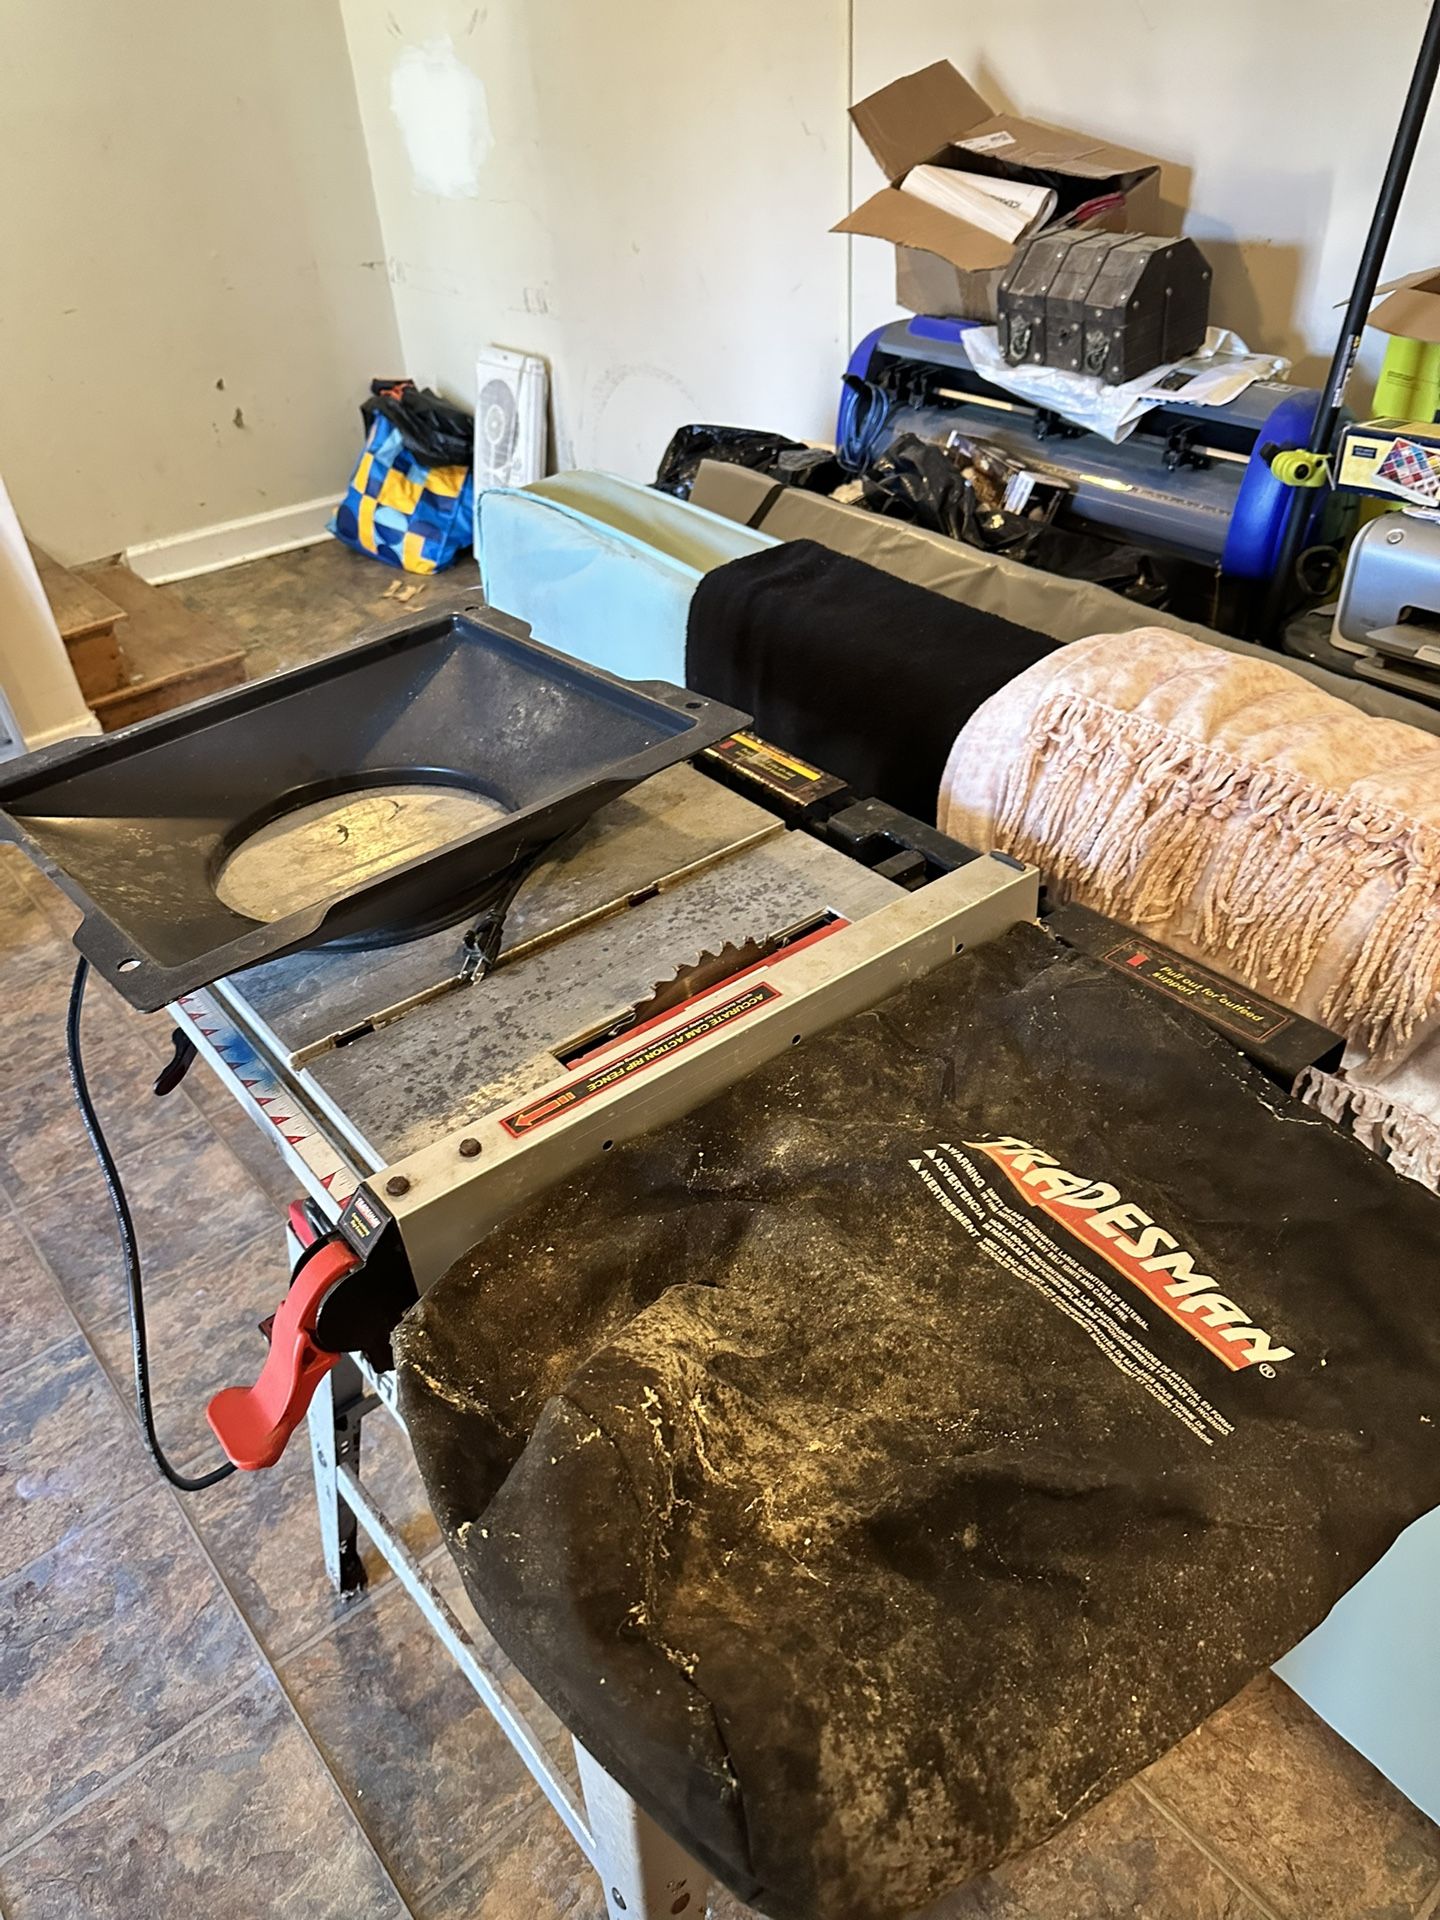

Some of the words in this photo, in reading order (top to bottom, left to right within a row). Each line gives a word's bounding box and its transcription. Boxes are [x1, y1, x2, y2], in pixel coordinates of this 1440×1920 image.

[1152, 972, 1196, 996] support
[1160, 966, 1185, 980] Pull
[1182, 979, 1204, 990] out
[1201, 988, 1220, 999] for
[1218, 997, 1265, 1023] outfeed
[709, 994, 763, 1026] ACCURATE
[645, 1036, 684, 1061] ACTION
[685, 1024, 710, 1039] CAM
[587, 1068, 626, 1092] FENCE
[627, 1058, 645, 1071] RIP
[934, 1159, 986, 1220] ADVERTENCIA
[949, 1148, 986, 1189] WARNING
[919, 1171, 980, 1237] AVERTISSEMENT
[970, 1136, 1295, 1363] TRADESMAN
[986, 1188, 1005, 1208] EMPTY
[1058, 1251, 1080, 1269] LARGE
[1078, 1267, 1113, 1296] QUANTITIES
[1110, 1294, 1122, 1303] OF
[1019, 1226, 1039, 1243] FORM
[1035, 1240, 1050, 1253] MAY
[1047, 1252, 1065, 1265] SELF
[1062, 1264, 1083, 1280] IGNITE
[1080, 1278, 1095, 1290] AND
[1092, 1288, 1116, 1309] CAUSE
[1112, 1307, 1129, 1323] FIRE.
[997, 1249, 1008, 1258] LE
[1005, 1255, 1020, 1268] SAC
[1114, 1349, 1126, 1360] DE
[1154, 1382, 1174, 1401] SOUS
[1172, 1399, 1197, 1422] FORME
[1195, 1420, 1207, 1431] DE
[1002, 1228, 1013, 1238] LA
[1080, 1295, 1095, 1308] LAS
[1094, 1307, 1133, 1341] CANTIDADES
[1131, 1340, 1162, 1367] GRANDES
[1160, 1365, 1172, 1374] DE
[1200, 1401, 1213, 1412] EN
[1210, 1410, 1236, 1432] FORMA
[1136, 1377, 1148, 1385] ET
[1145, 1384, 1173, 1409] CAUSER
[1171, 1407, 1184, 1419] UN
[1160, 1373, 1189, 1398] CAUSAR
[1186, 1397, 1199, 1408] UN
